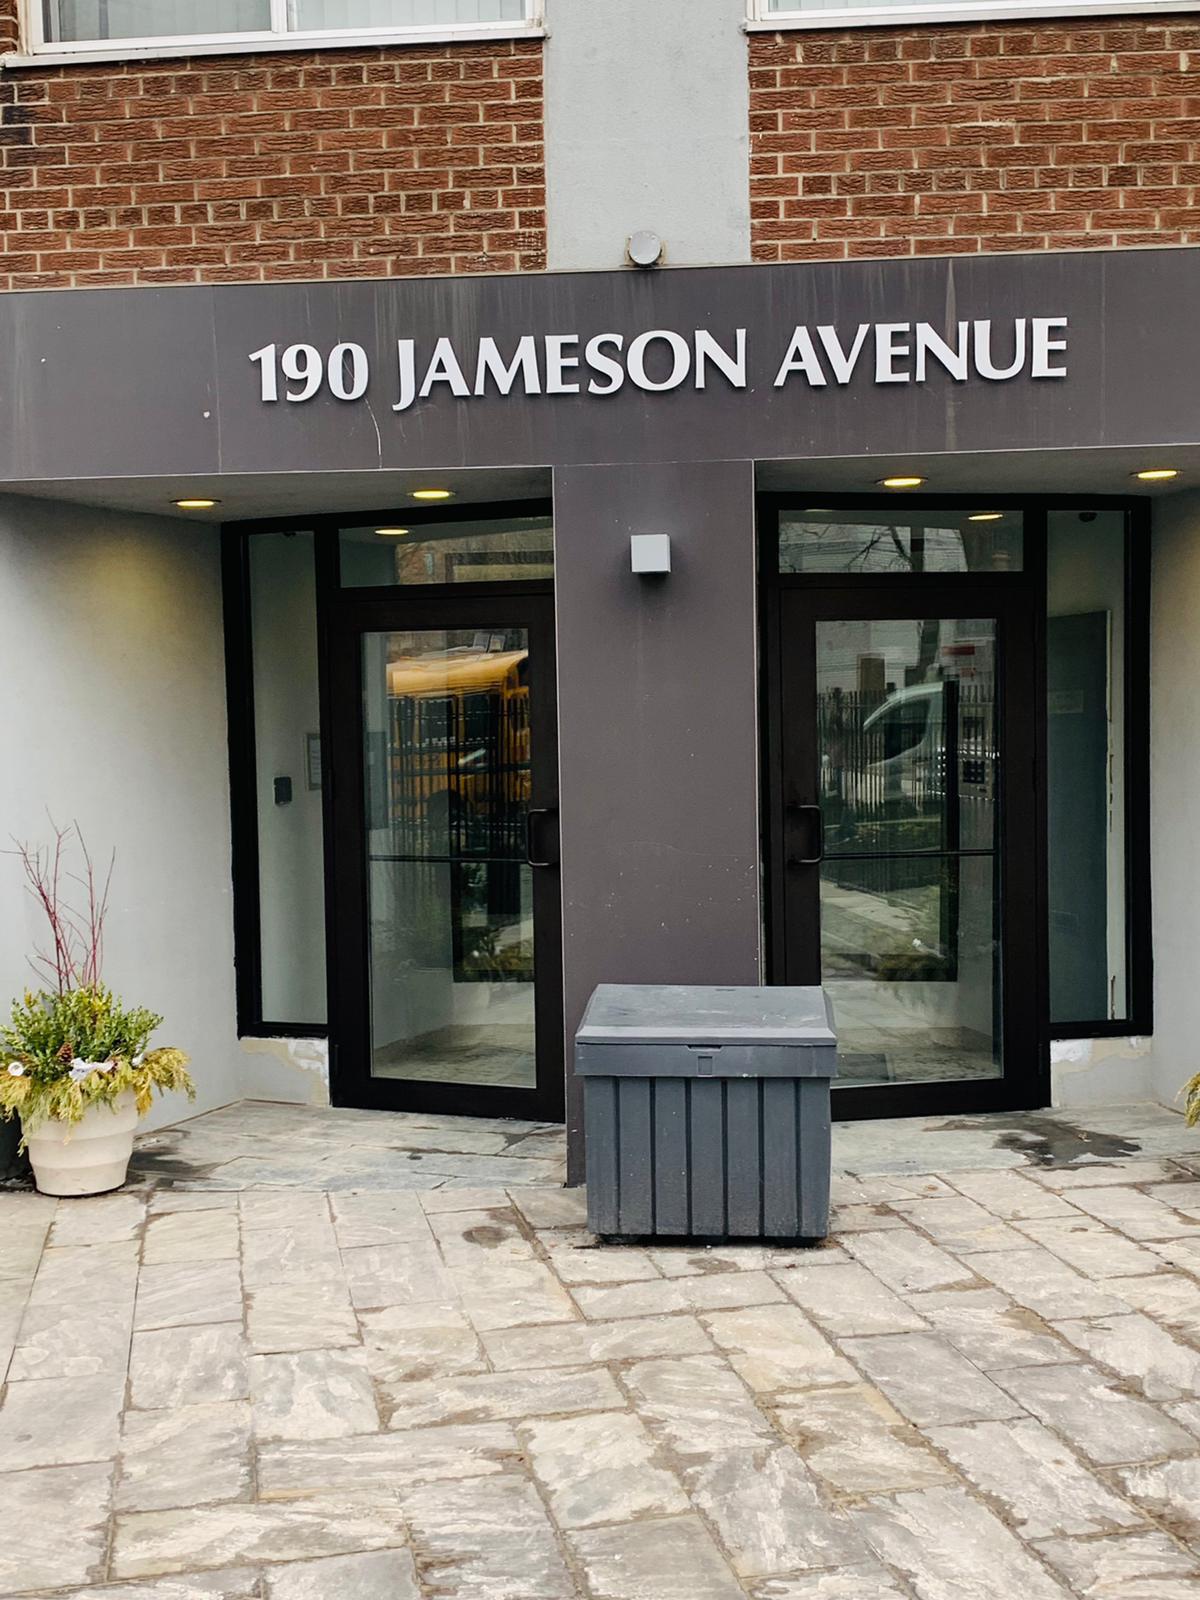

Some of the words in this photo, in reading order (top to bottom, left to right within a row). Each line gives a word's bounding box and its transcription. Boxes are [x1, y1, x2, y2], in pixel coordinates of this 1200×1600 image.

[248, 341, 369, 402] 190
[392, 328, 747, 411] JAMESON
[773, 316, 1069, 388] AVENUE
